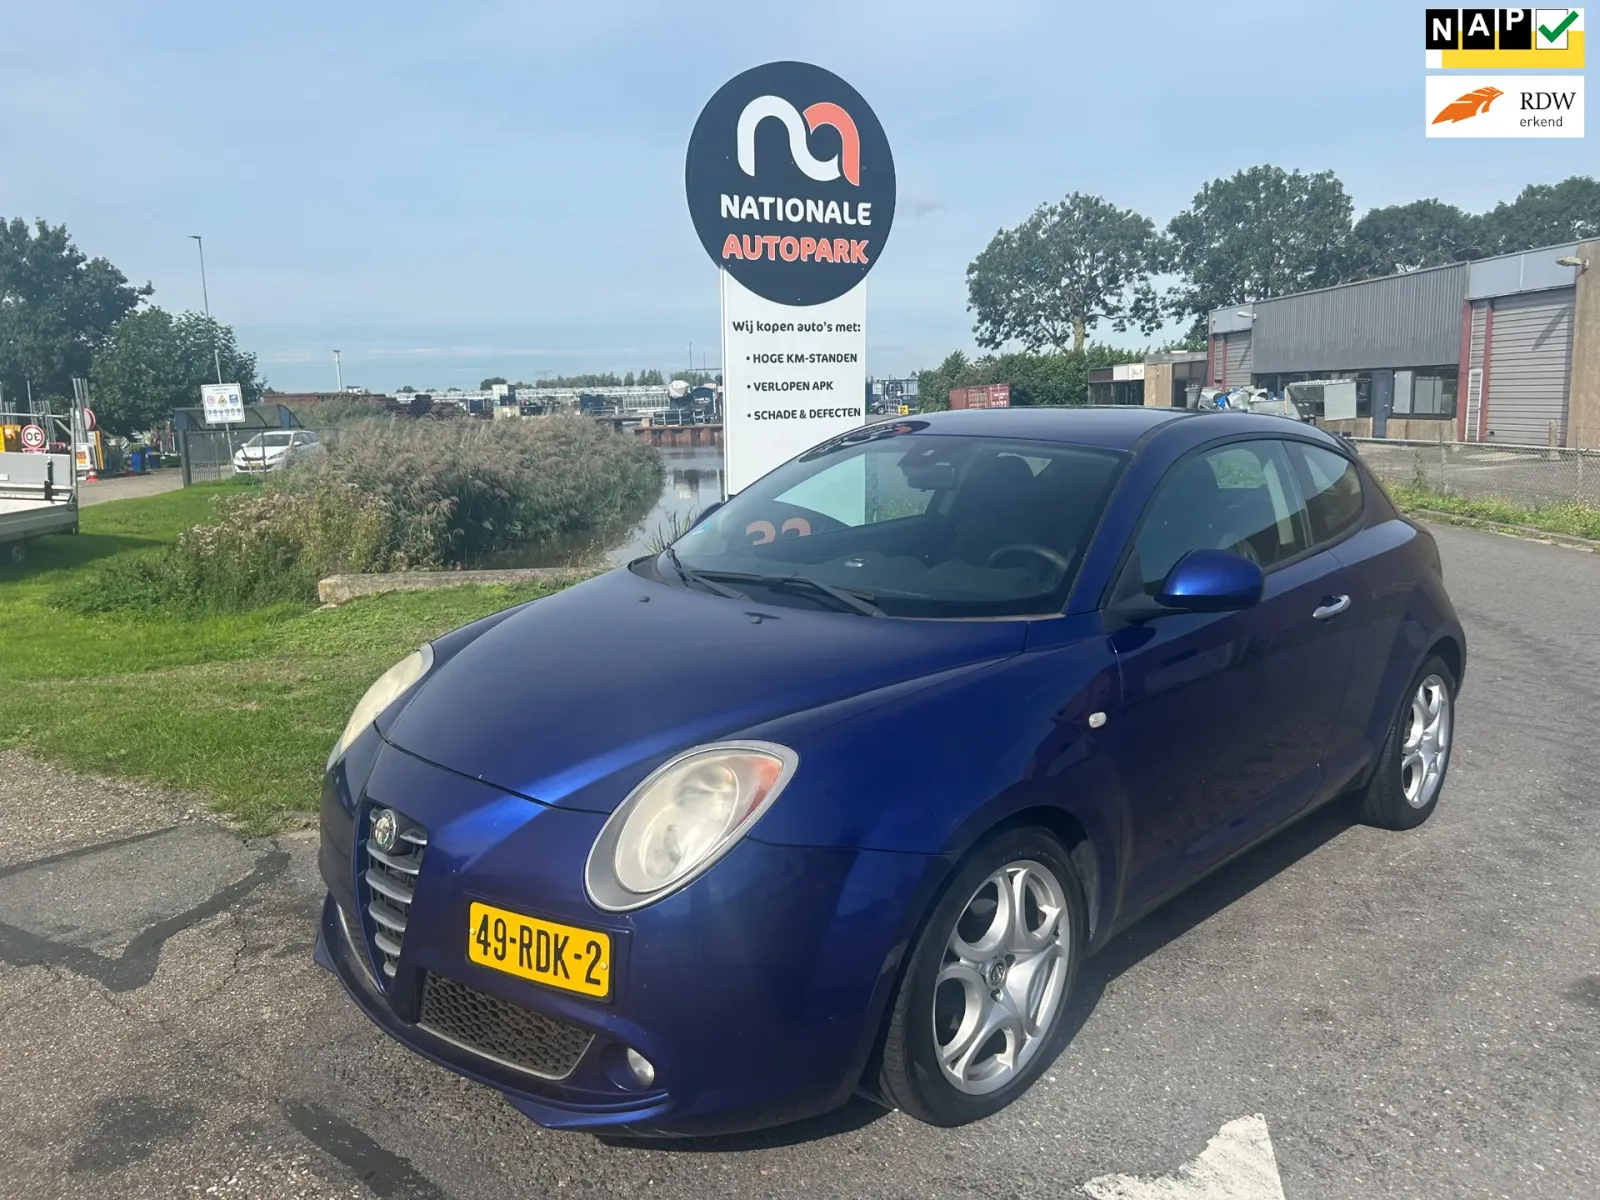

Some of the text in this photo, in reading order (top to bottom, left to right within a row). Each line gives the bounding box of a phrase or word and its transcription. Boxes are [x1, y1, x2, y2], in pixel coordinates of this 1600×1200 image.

[720, 193, 872, 226] NATIONALE
[722, 233, 869, 264] AUTOPARK
[732, 320, 861, 334] Wij kopen auto's met:
[753, 353, 858, 364] HOGE KM-STANDEN
[753, 381, 834, 391] VERLOPEN APK
[754, 408, 861, 420] SCHADE & DEFECTEN
[476, 913, 602, 986] 49-RDK-2
